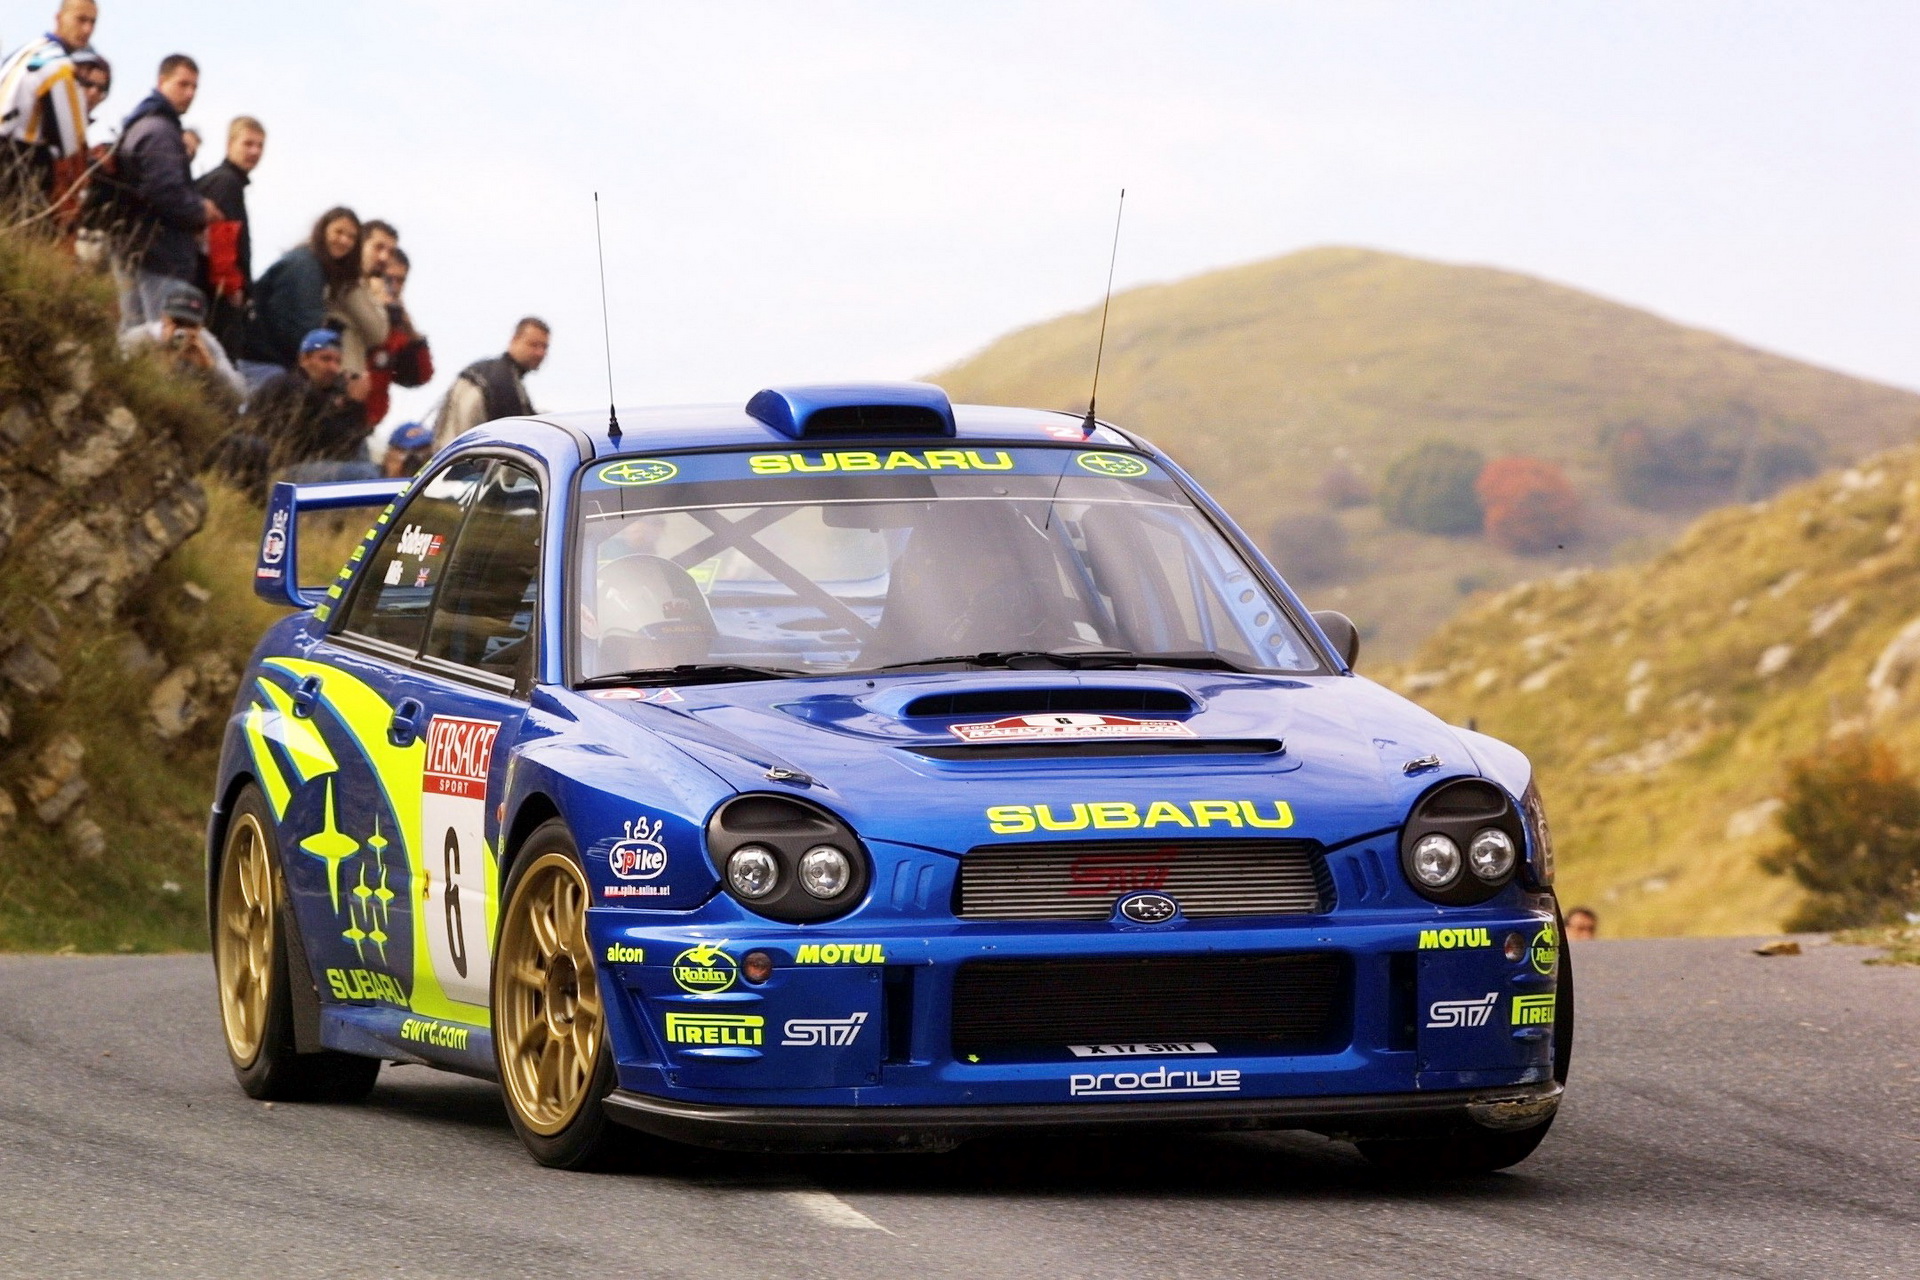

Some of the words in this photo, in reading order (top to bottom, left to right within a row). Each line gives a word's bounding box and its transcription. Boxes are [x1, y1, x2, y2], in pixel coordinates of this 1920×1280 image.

[749, 450, 1014, 474] SUBARU
[427, 720, 496, 778] VERSACE
[439, 779, 469, 794] SPORT
[985, 800, 1294, 834] SUBARU
[613, 847, 664, 875] Spike
[443, 826, 468, 979] 6
[606, 942, 644, 963] alcon
[1418, 928, 1491, 949] MOTUL
[795, 943, 886, 964] MOTUL
[326, 968, 408, 1007] SUBARU
[678, 966, 728, 984] Robin
[400, 1018, 469, 1051] swrt.com
[665, 1012, 765, 1045] PIRELLI
[1085, 1045, 1107, 1054] X
[1112, 1044, 1137, 1053] 17
[1069, 1066, 1241, 1096] prodrive
